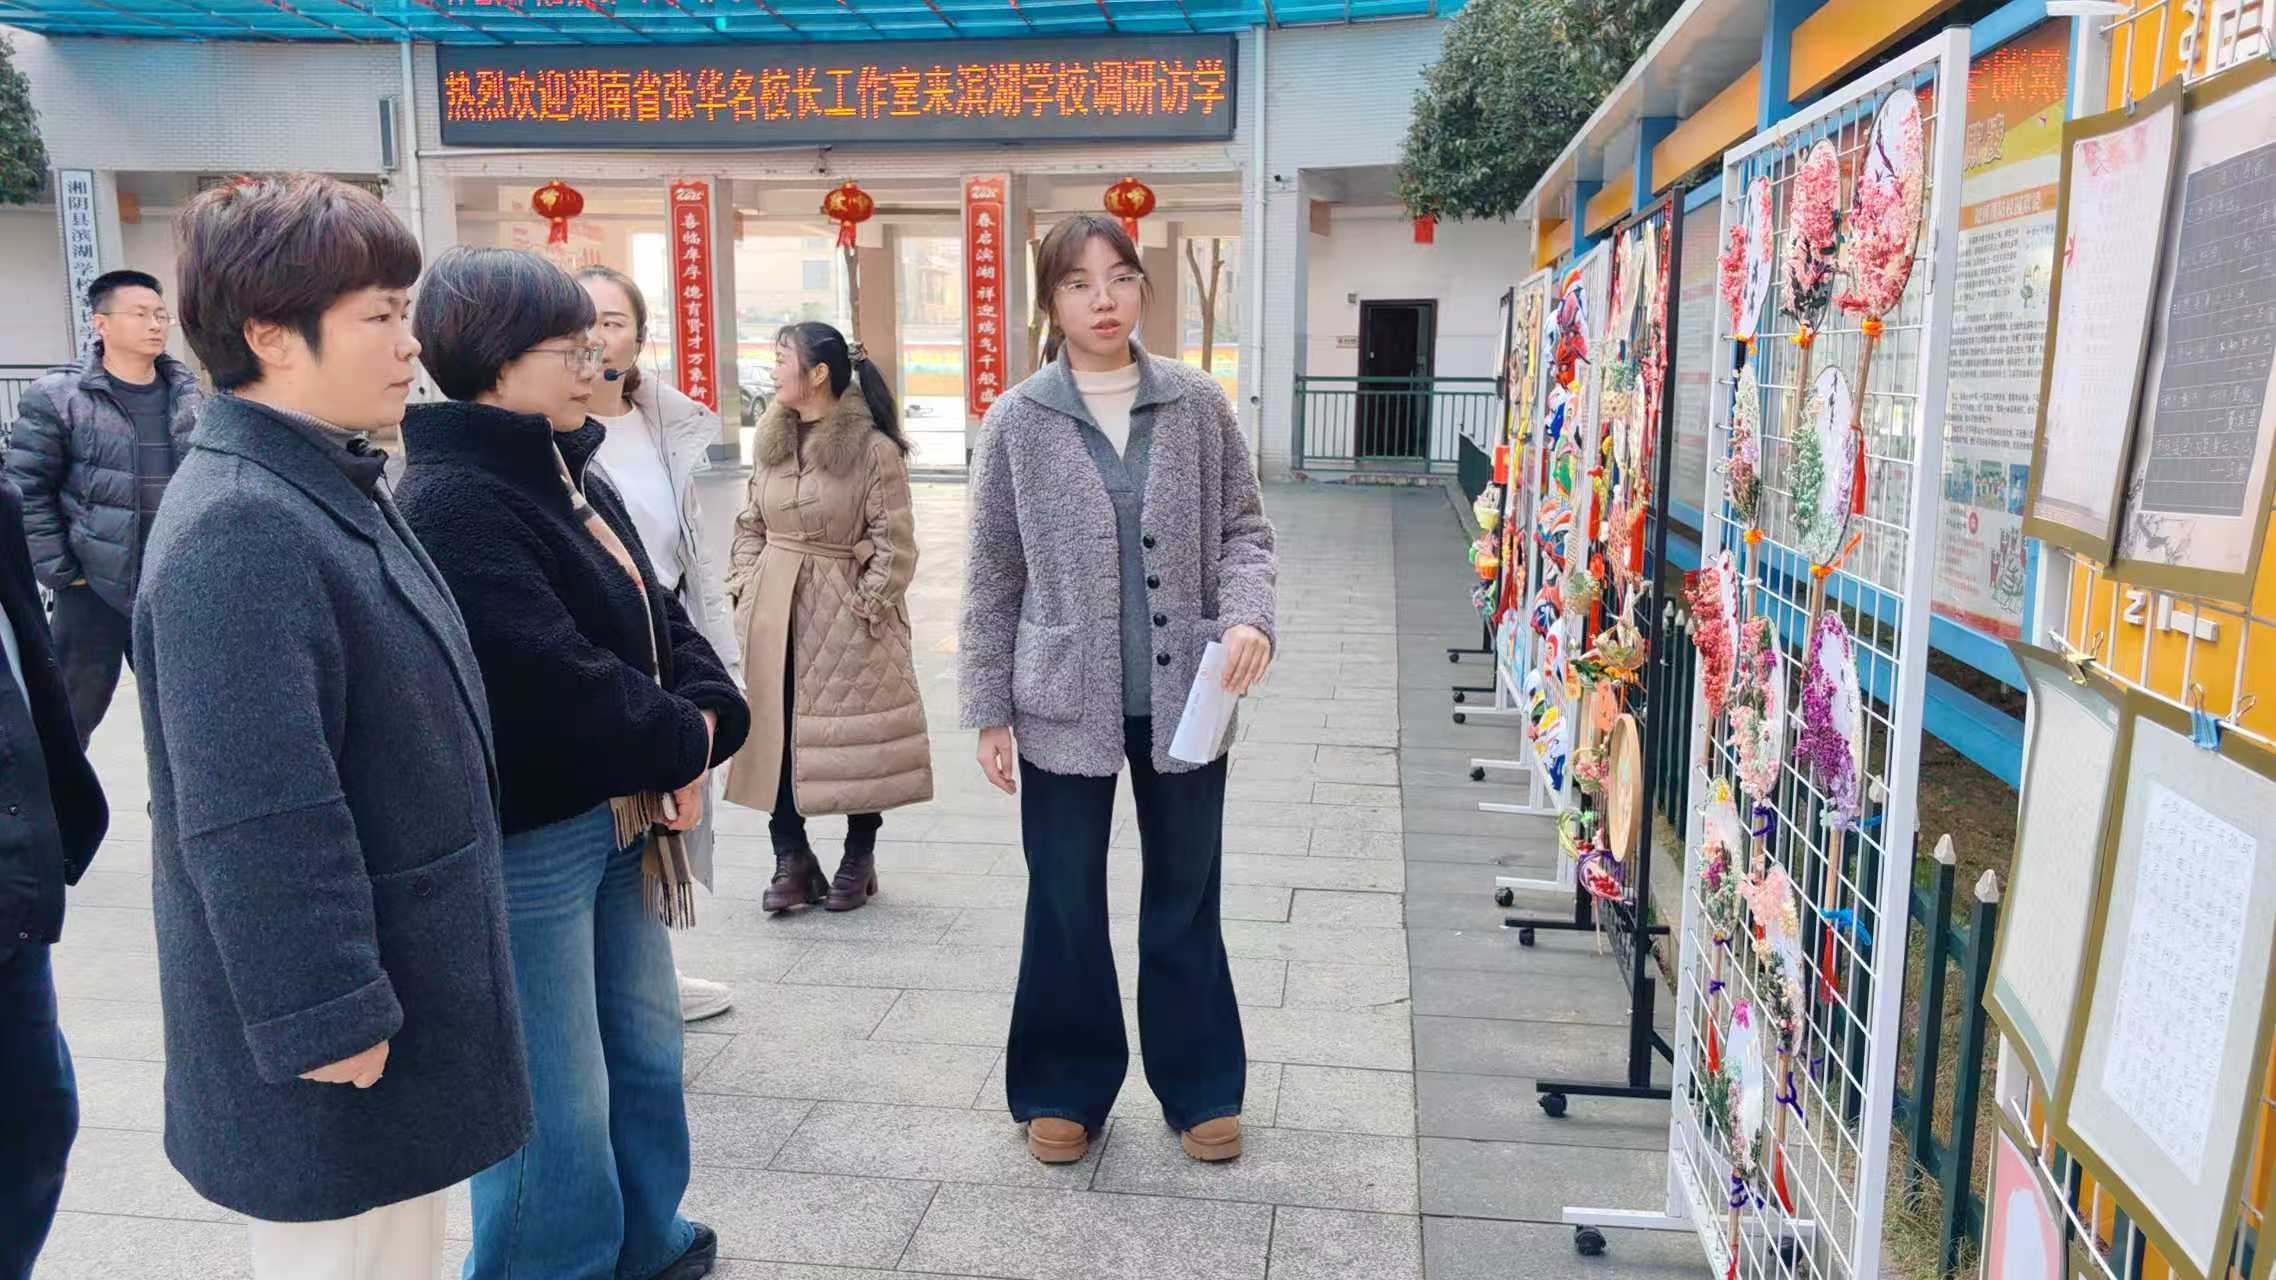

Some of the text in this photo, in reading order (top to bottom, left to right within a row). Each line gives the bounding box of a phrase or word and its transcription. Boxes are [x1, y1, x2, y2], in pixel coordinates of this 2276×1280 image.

[445, 58, 1226, 121] 热烈欢迎湖南省张华名校长工作室来滨湖学校调研访学
